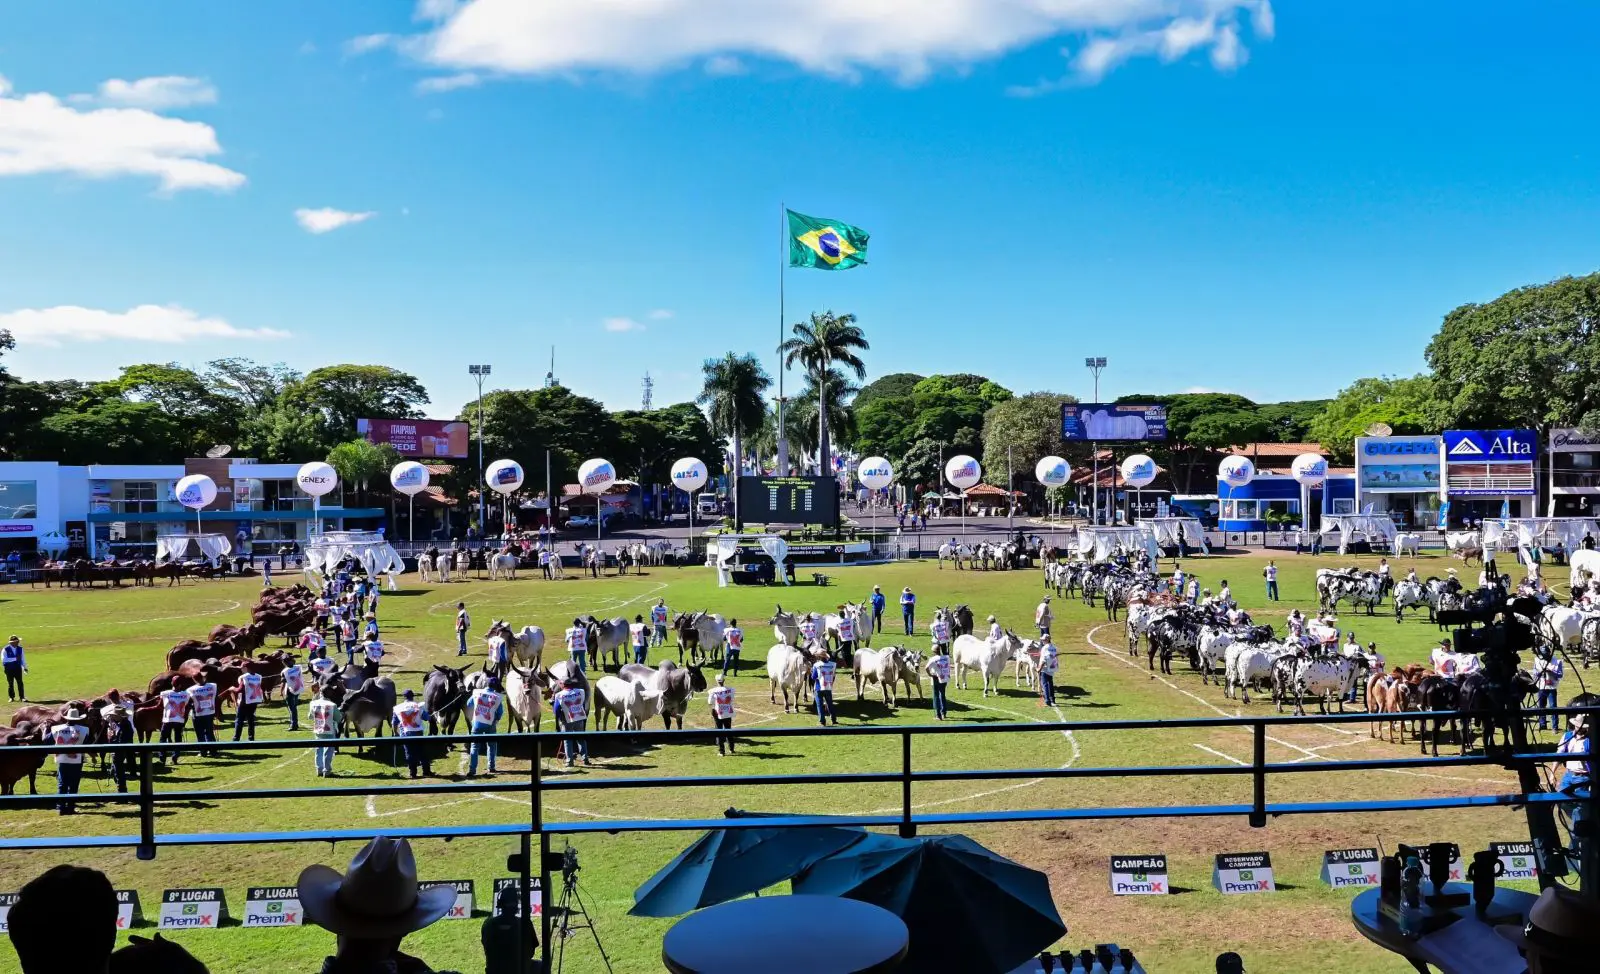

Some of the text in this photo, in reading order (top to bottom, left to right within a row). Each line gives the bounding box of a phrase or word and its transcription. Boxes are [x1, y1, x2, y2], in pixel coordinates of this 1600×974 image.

[391, 425, 416, 434] ITAIPAVA
[1489, 437, 1532, 454] Alta
[863, 468, 888, 476] CAIXA
[1332, 850, 1374, 860] 3º LUGAR
[1114, 858, 1164, 868] CAMPEÃO
[1335, 874, 1378, 886] PremiX
[1118, 882, 1163, 892] PremiX
[1226, 880, 1269, 892] PremiX
[169, 891, 214, 902] 8º LUGAR
[254, 888, 298, 899] 9º LUGAR
[164, 915, 212, 926] PremiX
[248, 912, 296, 924] PremiX
